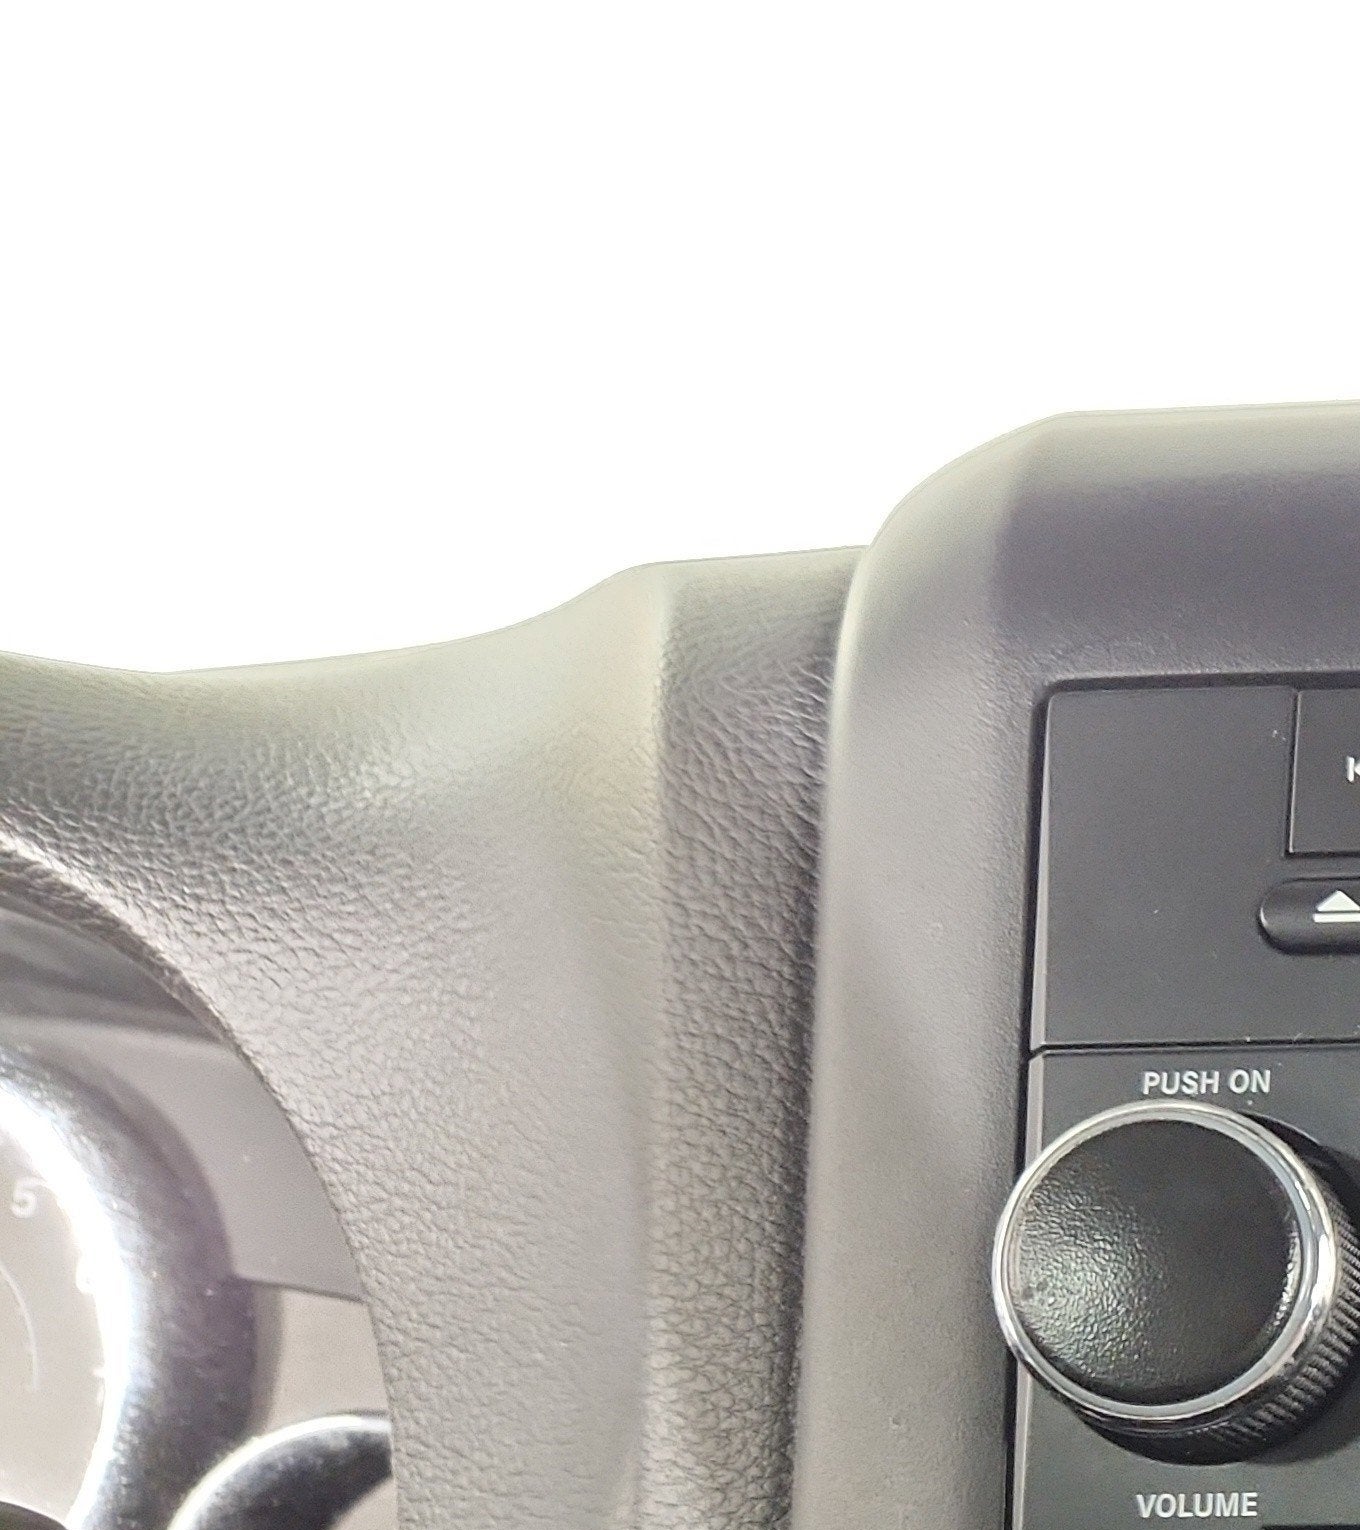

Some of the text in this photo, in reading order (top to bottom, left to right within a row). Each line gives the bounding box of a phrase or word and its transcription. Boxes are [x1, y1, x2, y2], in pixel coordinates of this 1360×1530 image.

[1142, 1069, 1271, 1095] PUSH ON
[1136, 1492, 1258, 1518] VOLUME
